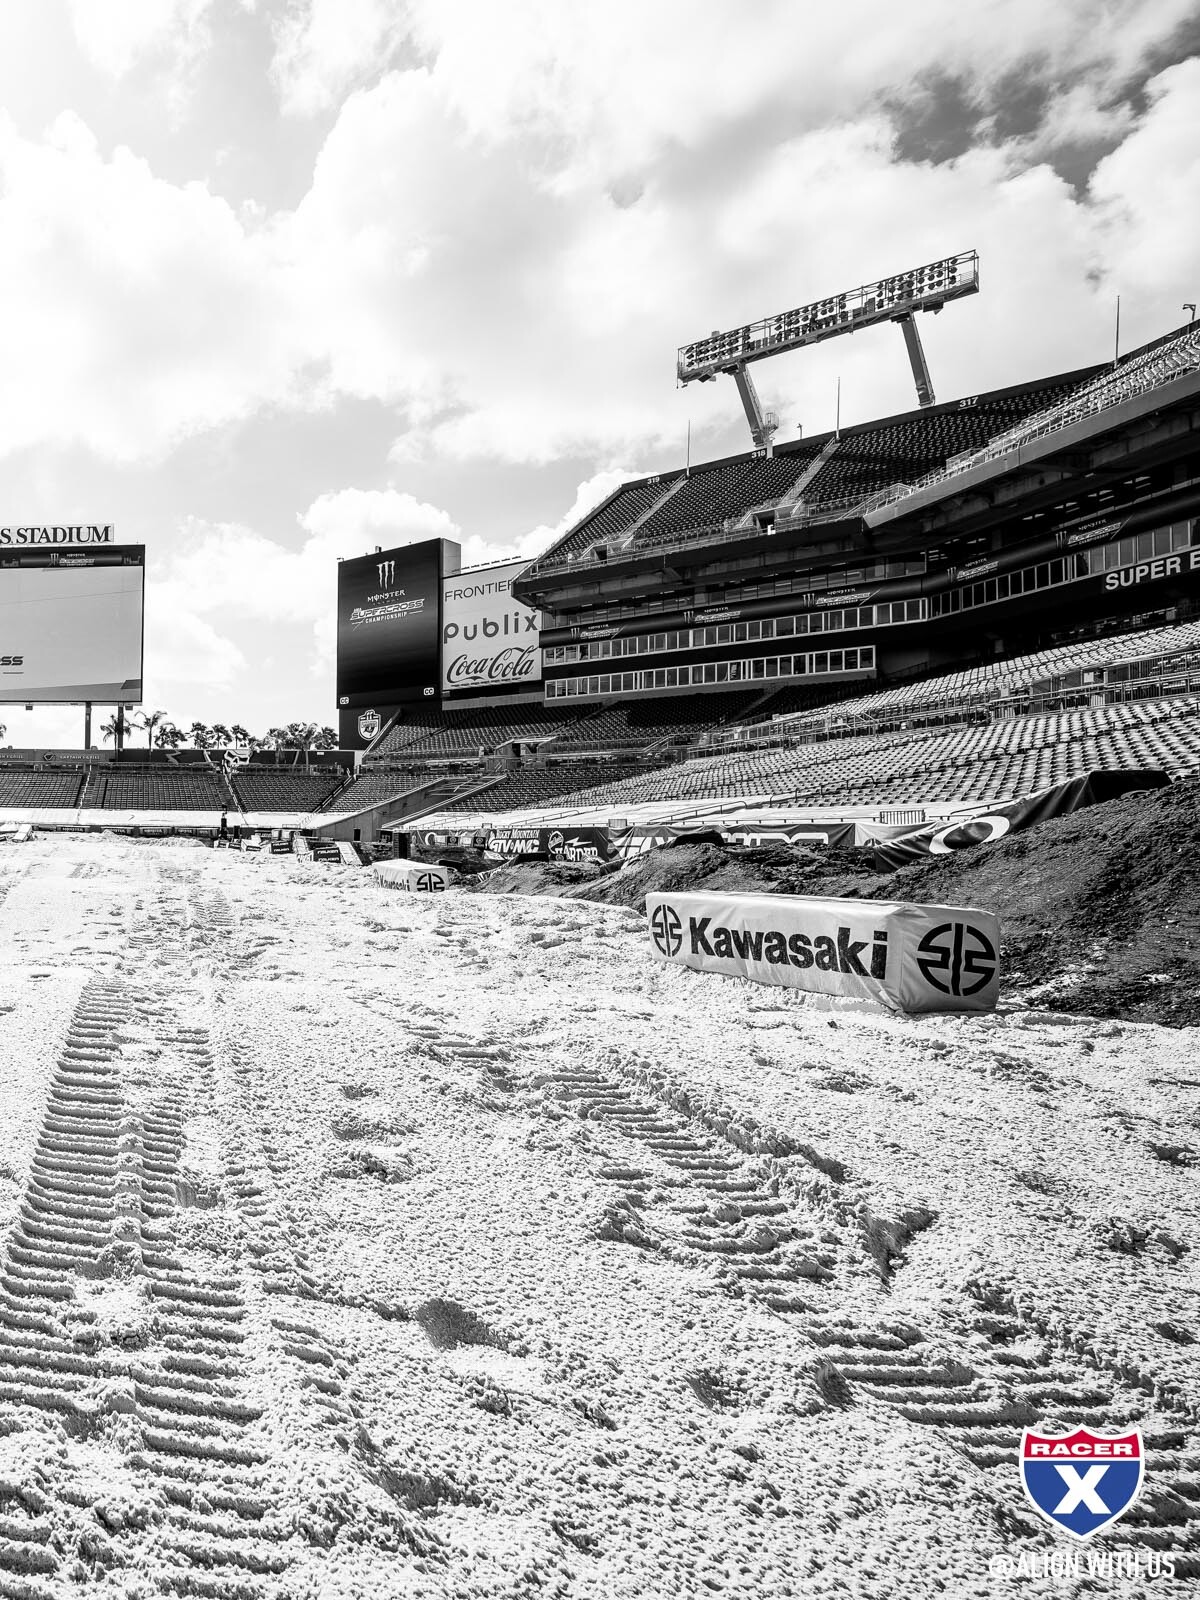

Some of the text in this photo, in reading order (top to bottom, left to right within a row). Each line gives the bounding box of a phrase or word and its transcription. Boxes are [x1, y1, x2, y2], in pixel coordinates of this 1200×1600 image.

[959, 397, 979, 407] 317
[751, 449, 766, 458] 318
[647, 476, 660, 484] 319
[16, 525, 112, 544] STADIUM
[1105, 556, 1181, 590] SUPER
[367, 589, 406, 602] MONSTER
[365, 612, 408, 624] CHAMPIONSHIP
[443, 612, 538, 644] Publix
[446, 645, 540, 683] Coca-Cola
[689, 916, 888, 981] Kawasaki
